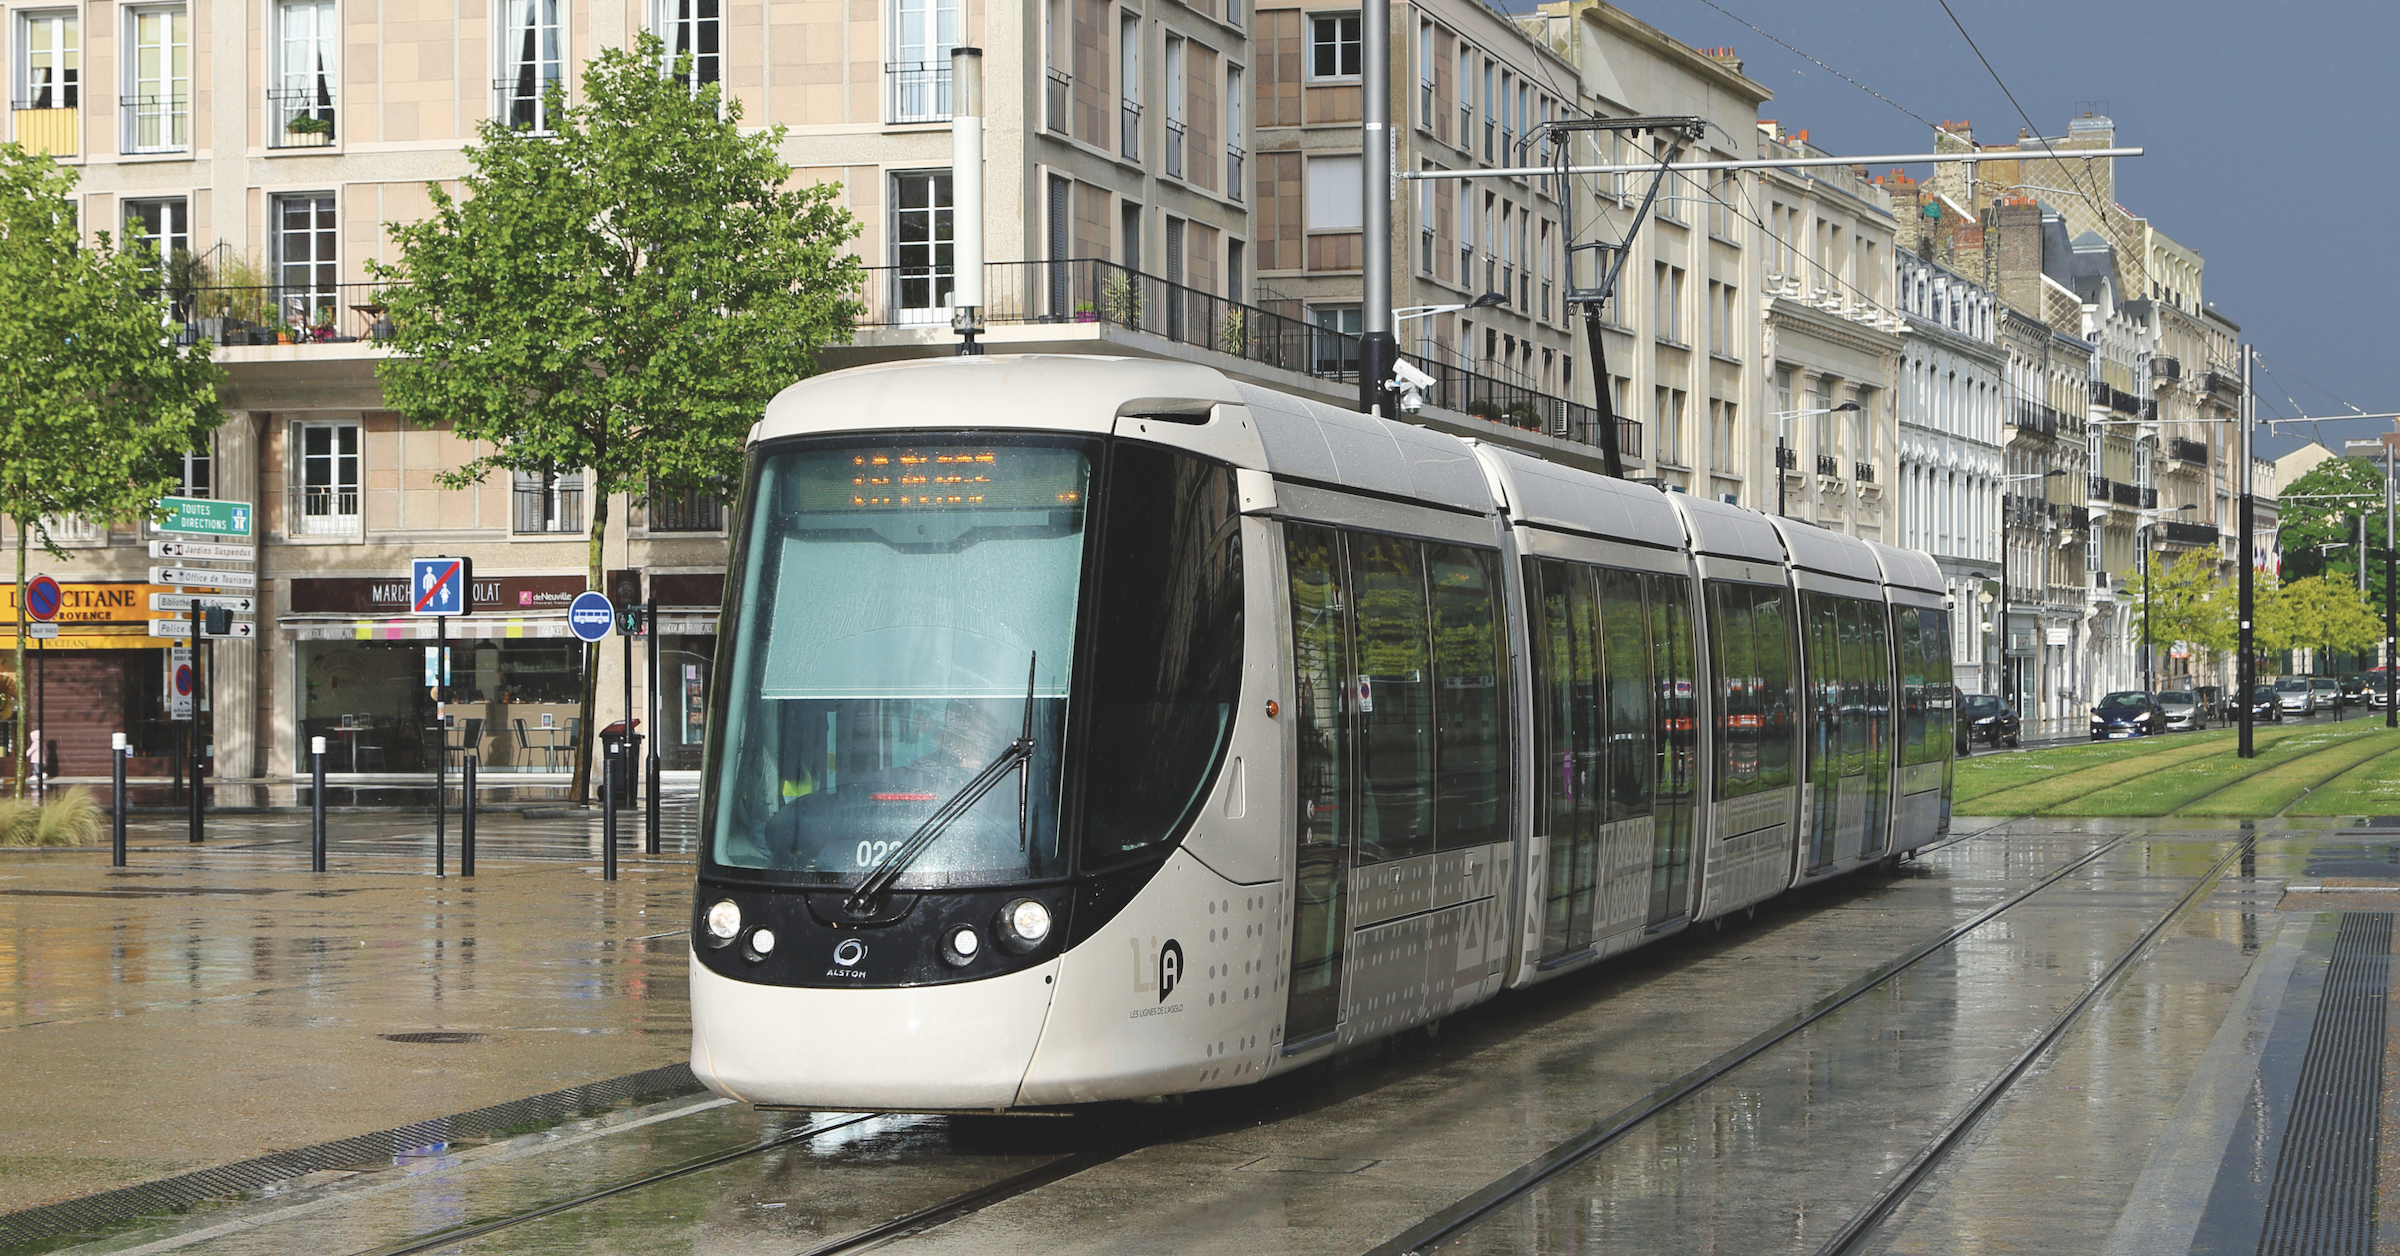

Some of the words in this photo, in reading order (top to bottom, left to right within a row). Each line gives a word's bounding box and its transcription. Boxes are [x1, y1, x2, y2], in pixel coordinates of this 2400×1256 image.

[181, 503, 211, 516] TOUTES
[181, 517, 227, 530] DIRECTIONS
[185, 545, 211, 555] Jardins
[214, 547, 251, 557] Suspendus
[185, 572, 207, 582] Office
[210, 575, 219, 583] de
[222, 574, 252, 585] Tourisme
[9, 590, 136, 608] LCITANE
[372, 584, 412, 602] MARCH
[472, 583, 501, 601] OLAT
[533, 592, 572, 601] deNeuville
[53, 611, 112, 620] ROVENCE
[161, 623, 187, 634] Police
[826, 968, 867, 979] ALSTOM
[1130, 1010, 1139, 1019] LES
[1140, 1007, 1157, 1018] LIGNES
[1157, 1006, 1164, 1015] DE
